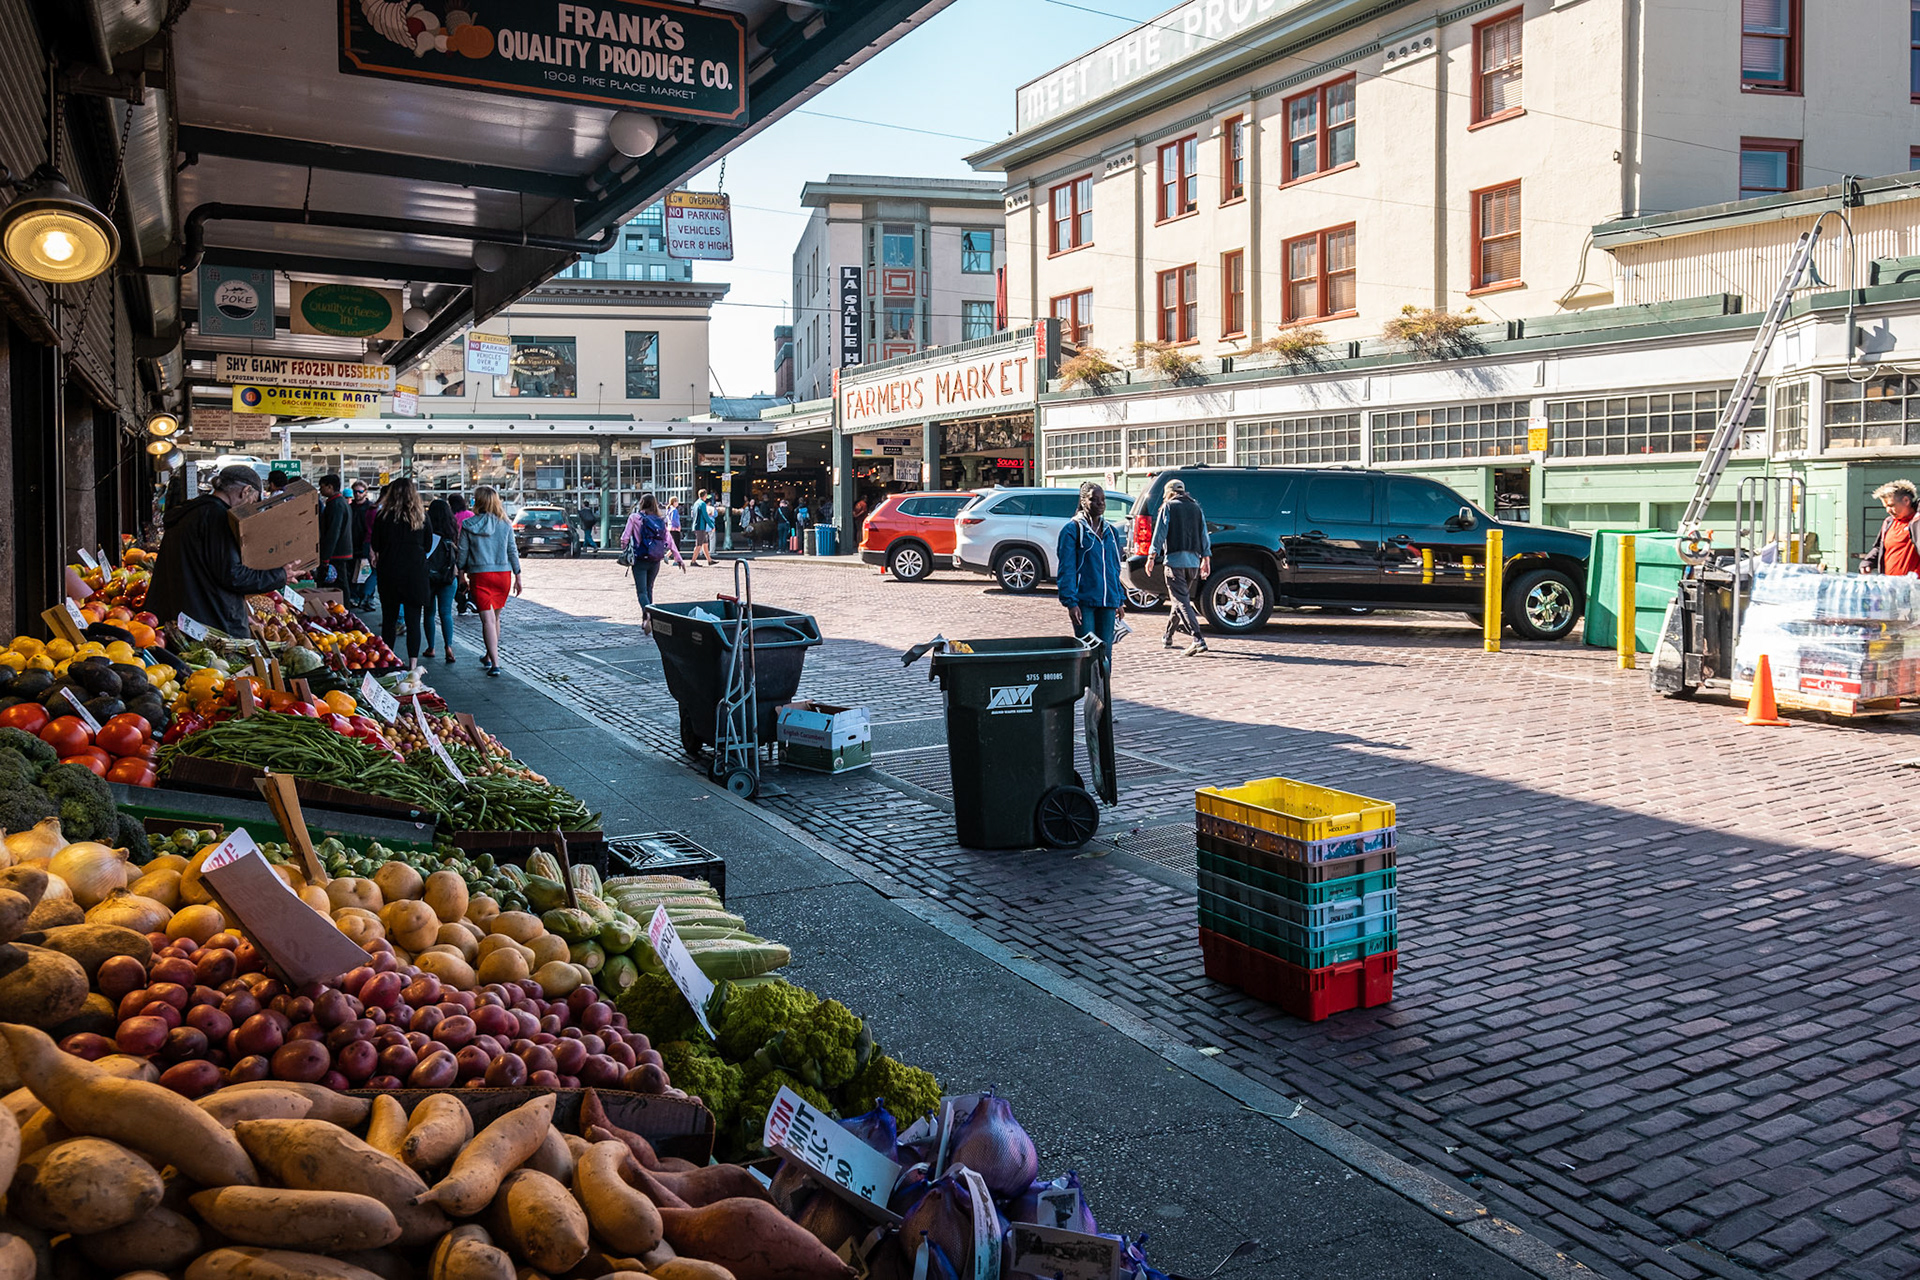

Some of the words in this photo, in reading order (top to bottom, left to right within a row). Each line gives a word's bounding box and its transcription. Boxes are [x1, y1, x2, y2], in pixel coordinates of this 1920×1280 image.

[558, 3, 686, 50] FRANK'S
[498, 28, 592, 70] QUALITY
[599, 44, 696, 85] PRODUCE
[701, 60, 733, 90] CO.
[1026, 62, 1092, 121] MEET
[1106, 26, 1162, 82] THE
[543, 71, 577, 84] 1908
[582, 76, 606, 89] PIKE
[610, 80, 647, 94] PLACE
[651, 87, 698, 101] MARKET
[669, 207, 682, 217] NO
[687, 211, 725, 221] PARKING
[677, 225, 721, 236] VEHICLES
[671, 239, 696, 249] OVER
[707, 241, 729, 251] HIGH
[843, 268, 859, 289] LA
[221, 294, 253, 304] POKE
[309, 300, 347, 316] Quality
[347, 305, 384, 318] Cheese
[843, 294, 859, 348] SALLE
[481, 343, 508, 353] PARKING
[226, 356, 248, 372] SHY
[251, 358, 288, 375] GIANT
[291, 361, 335, 378] FROZEN
[337, 363, 390, 381] DESSERTS
[298, 378, 318, 386] CREAM
[845, 376, 924, 421] FARMERS
[935, 355, 1029, 407] MARKET
[267, 388, 336, 401] ORIENTAL
[342, 392, 378, 403] MART
[997, 457, 1019, 467] SOUND
[1817, 679, 1844, 692] Coke
[783, 728, 800, 738] English
[800, 731, 826, 741] Cucumbers
